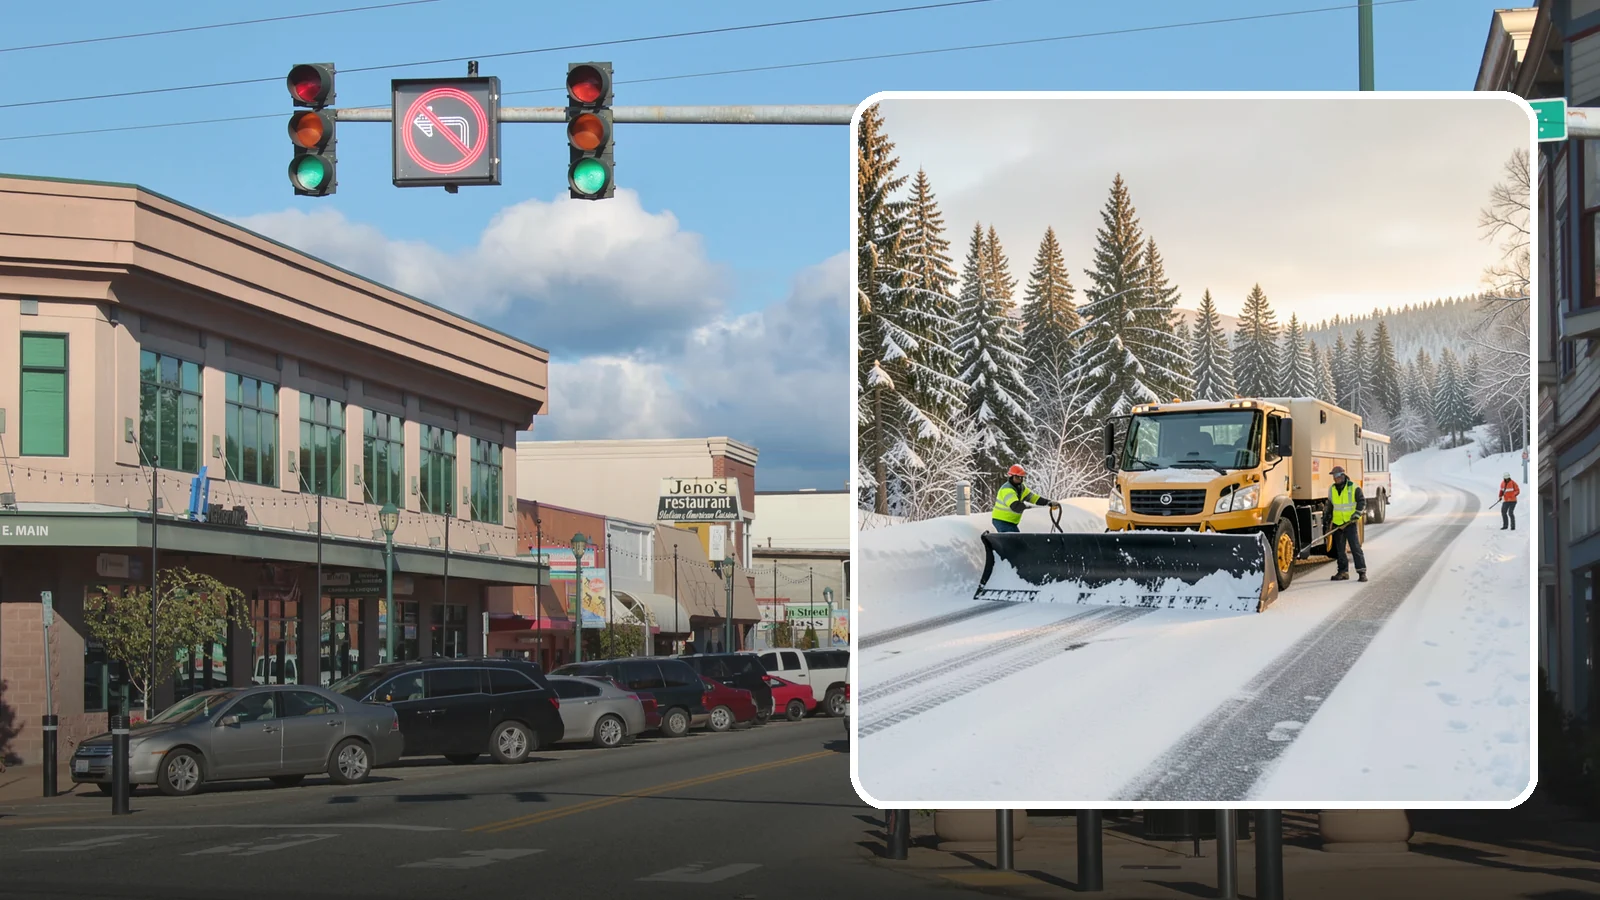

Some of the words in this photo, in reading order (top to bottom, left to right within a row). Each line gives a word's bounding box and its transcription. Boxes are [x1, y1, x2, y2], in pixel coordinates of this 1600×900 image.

[669, 480, 727, 494] Jeno's
[665, 496, 731, 509] restaurant
[658, 509, 681, 519] Italian
[686, 509, 715, 519] American
[715, 509, 737, 519] Cuisine
[2, 525, 13, 536] E.
[15, 525, 49, 536] MAIN
[797, 607, 828, 616] Street
